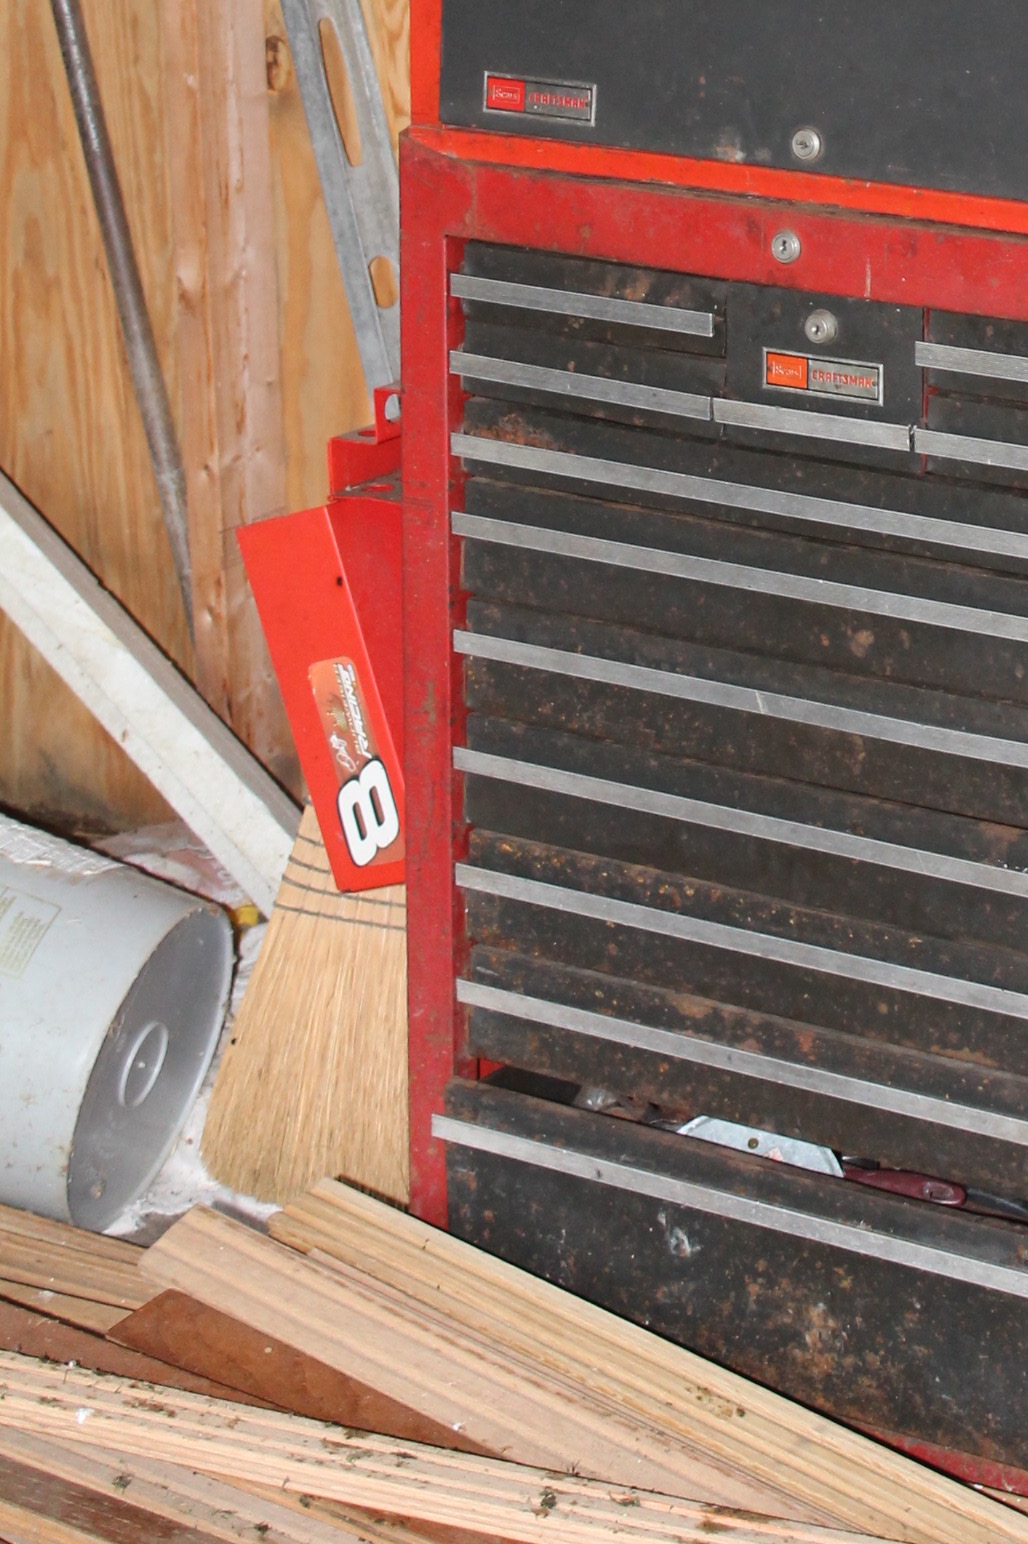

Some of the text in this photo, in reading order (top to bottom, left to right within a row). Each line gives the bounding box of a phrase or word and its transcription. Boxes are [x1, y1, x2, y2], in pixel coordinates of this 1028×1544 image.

[811, 370, 872, 388] CRAFTSMAN
[338, 663, 373, 759] RACING
[338, 759, 400, 867] 8
